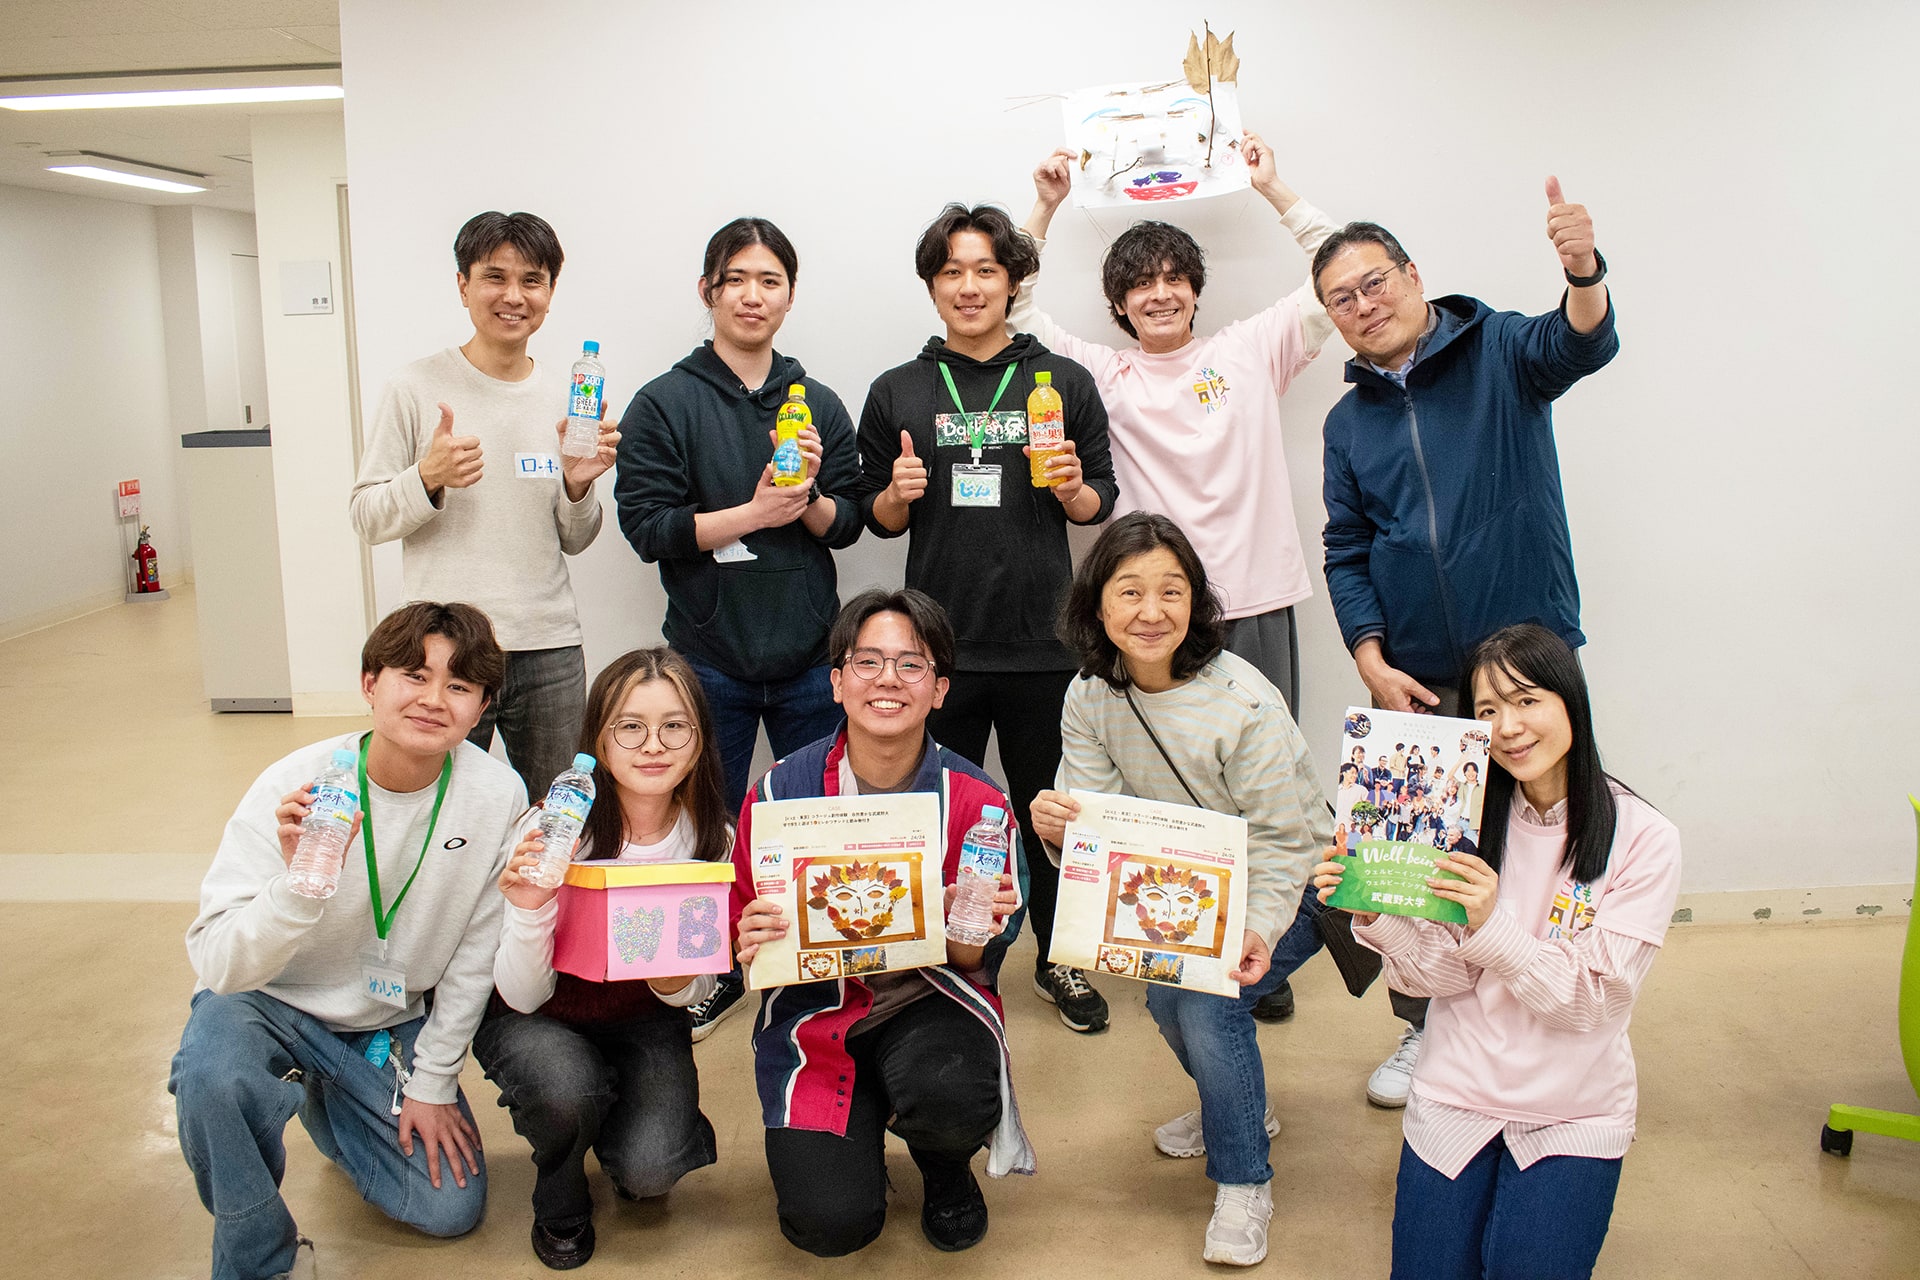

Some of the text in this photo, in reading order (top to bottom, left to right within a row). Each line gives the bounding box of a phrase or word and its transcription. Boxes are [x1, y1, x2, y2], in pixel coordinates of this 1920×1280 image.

[960, 482, 990, 497] じん
[1371, 892, 1426, 908] 武蔵野大学
